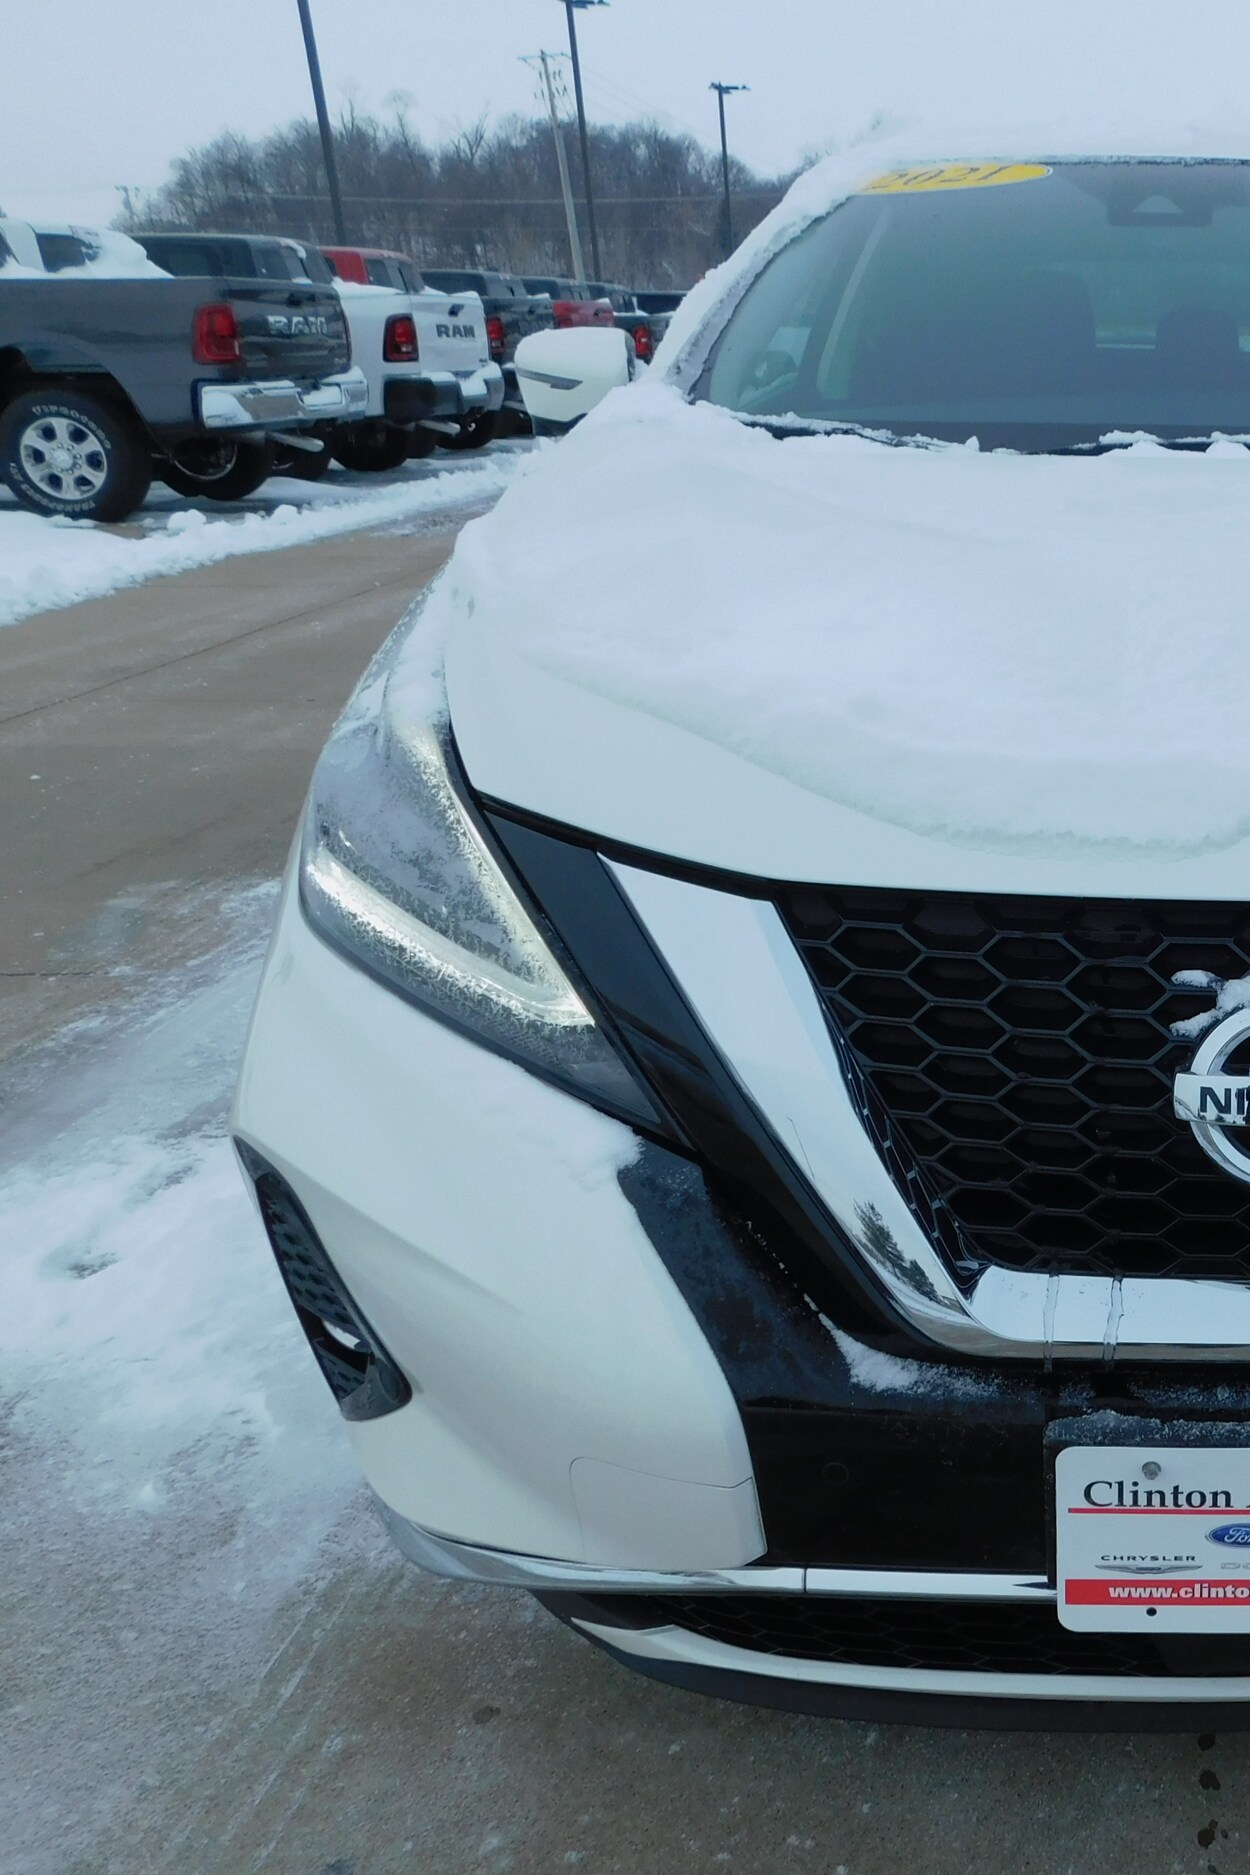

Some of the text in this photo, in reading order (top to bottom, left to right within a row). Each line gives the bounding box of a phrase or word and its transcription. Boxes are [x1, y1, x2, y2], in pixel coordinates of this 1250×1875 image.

[267, 314, 328, 335] RAM
[436, 323, 476, 338] RAM
[1083, 1480, 1233, 1509] Clinton
[1101, 1554, 1196, 1562] CHRYSLER
